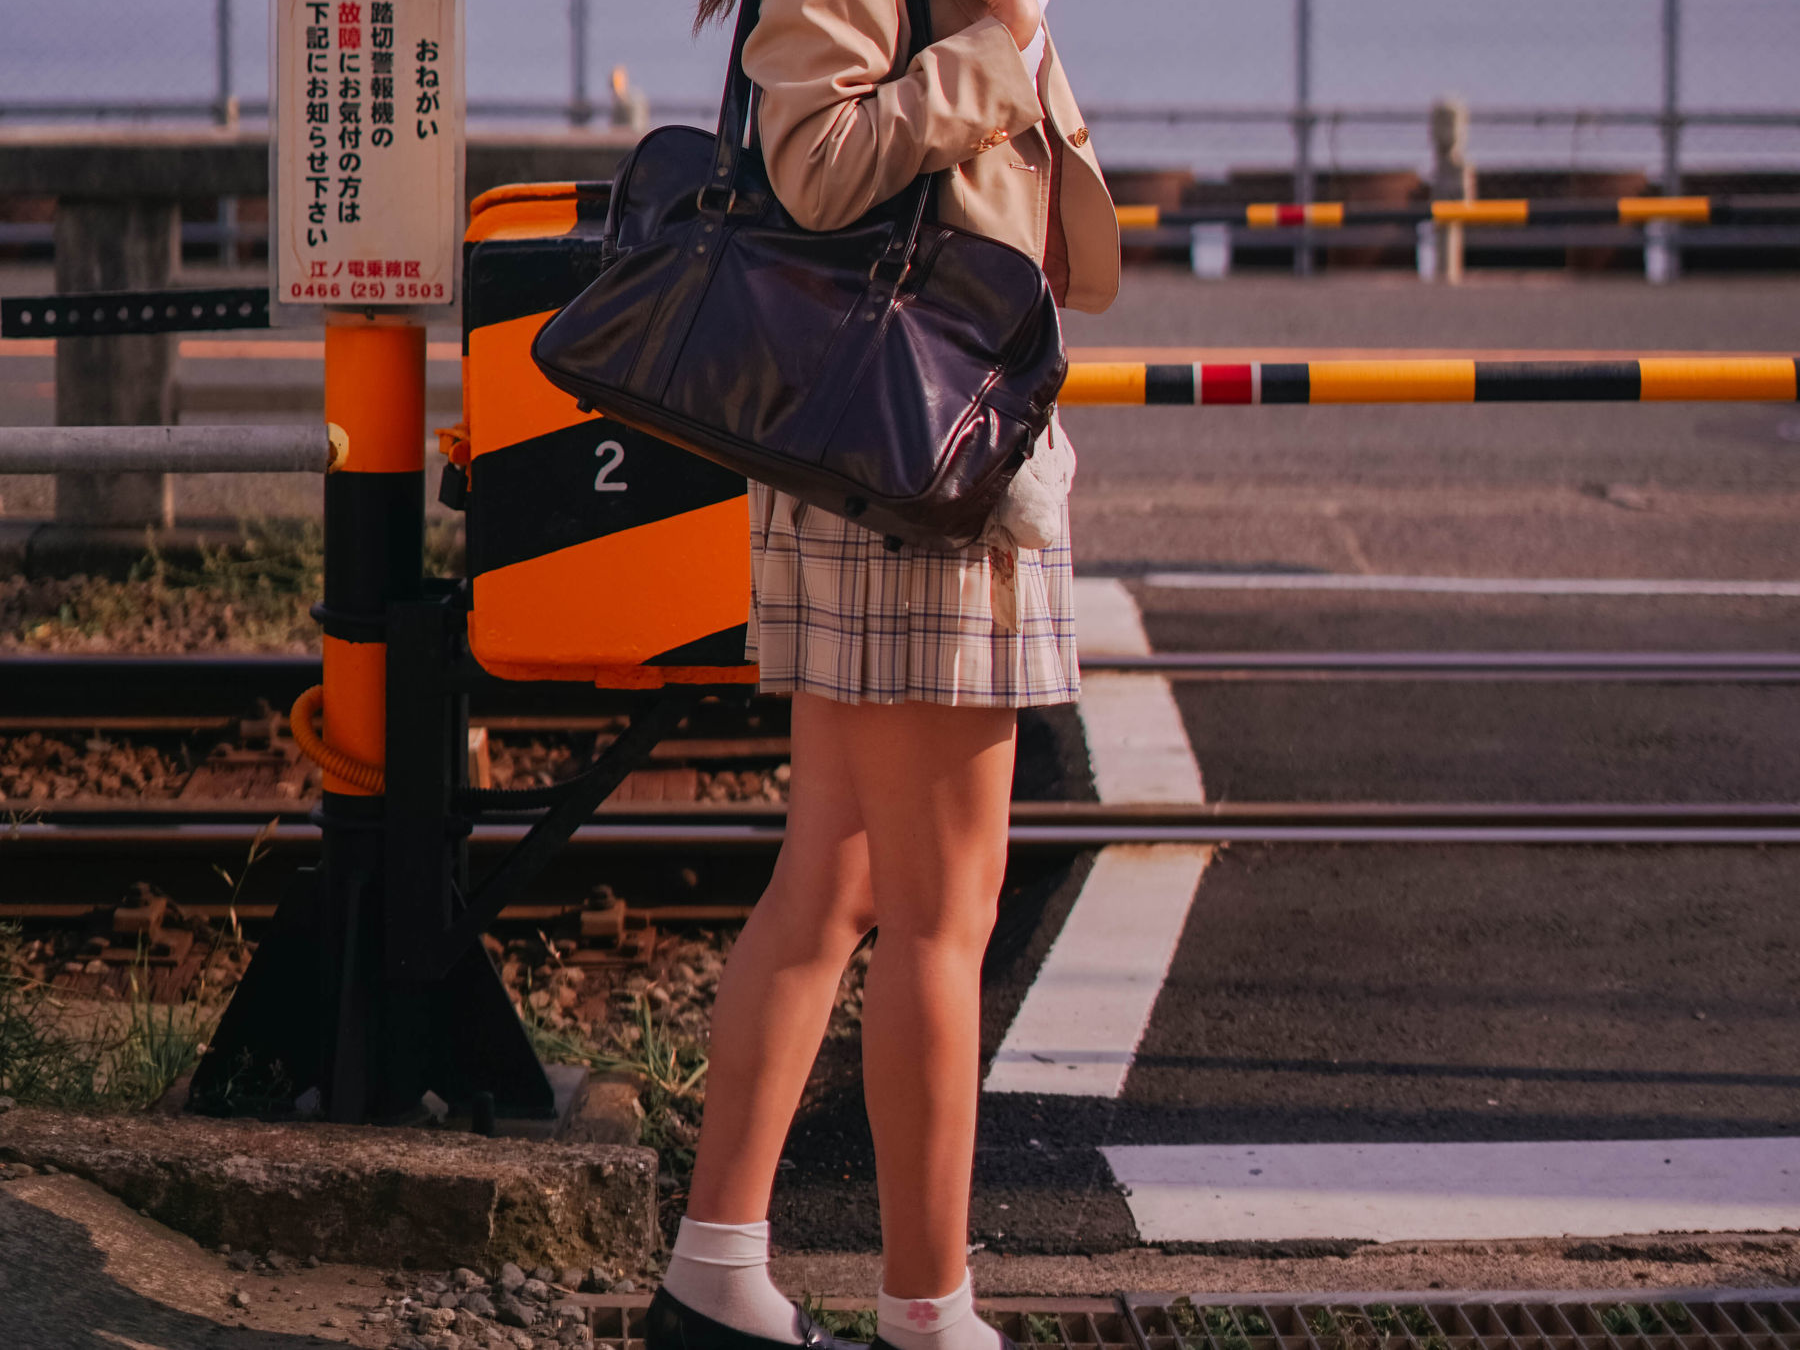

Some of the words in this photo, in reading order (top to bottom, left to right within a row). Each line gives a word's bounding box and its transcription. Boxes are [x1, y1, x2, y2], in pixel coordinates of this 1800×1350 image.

[305, 2, 330, 247] 下記にお知らせ下さい
[337, 1, 362, 224] 故障にお気付の方は
[370, 1, 394, 148] 踏切警報機の
[415, 38, 440, 139] おねがい
[311, 260, 421, 279] 江ノ電乗務区
[594, 440, 628, 492] 2
